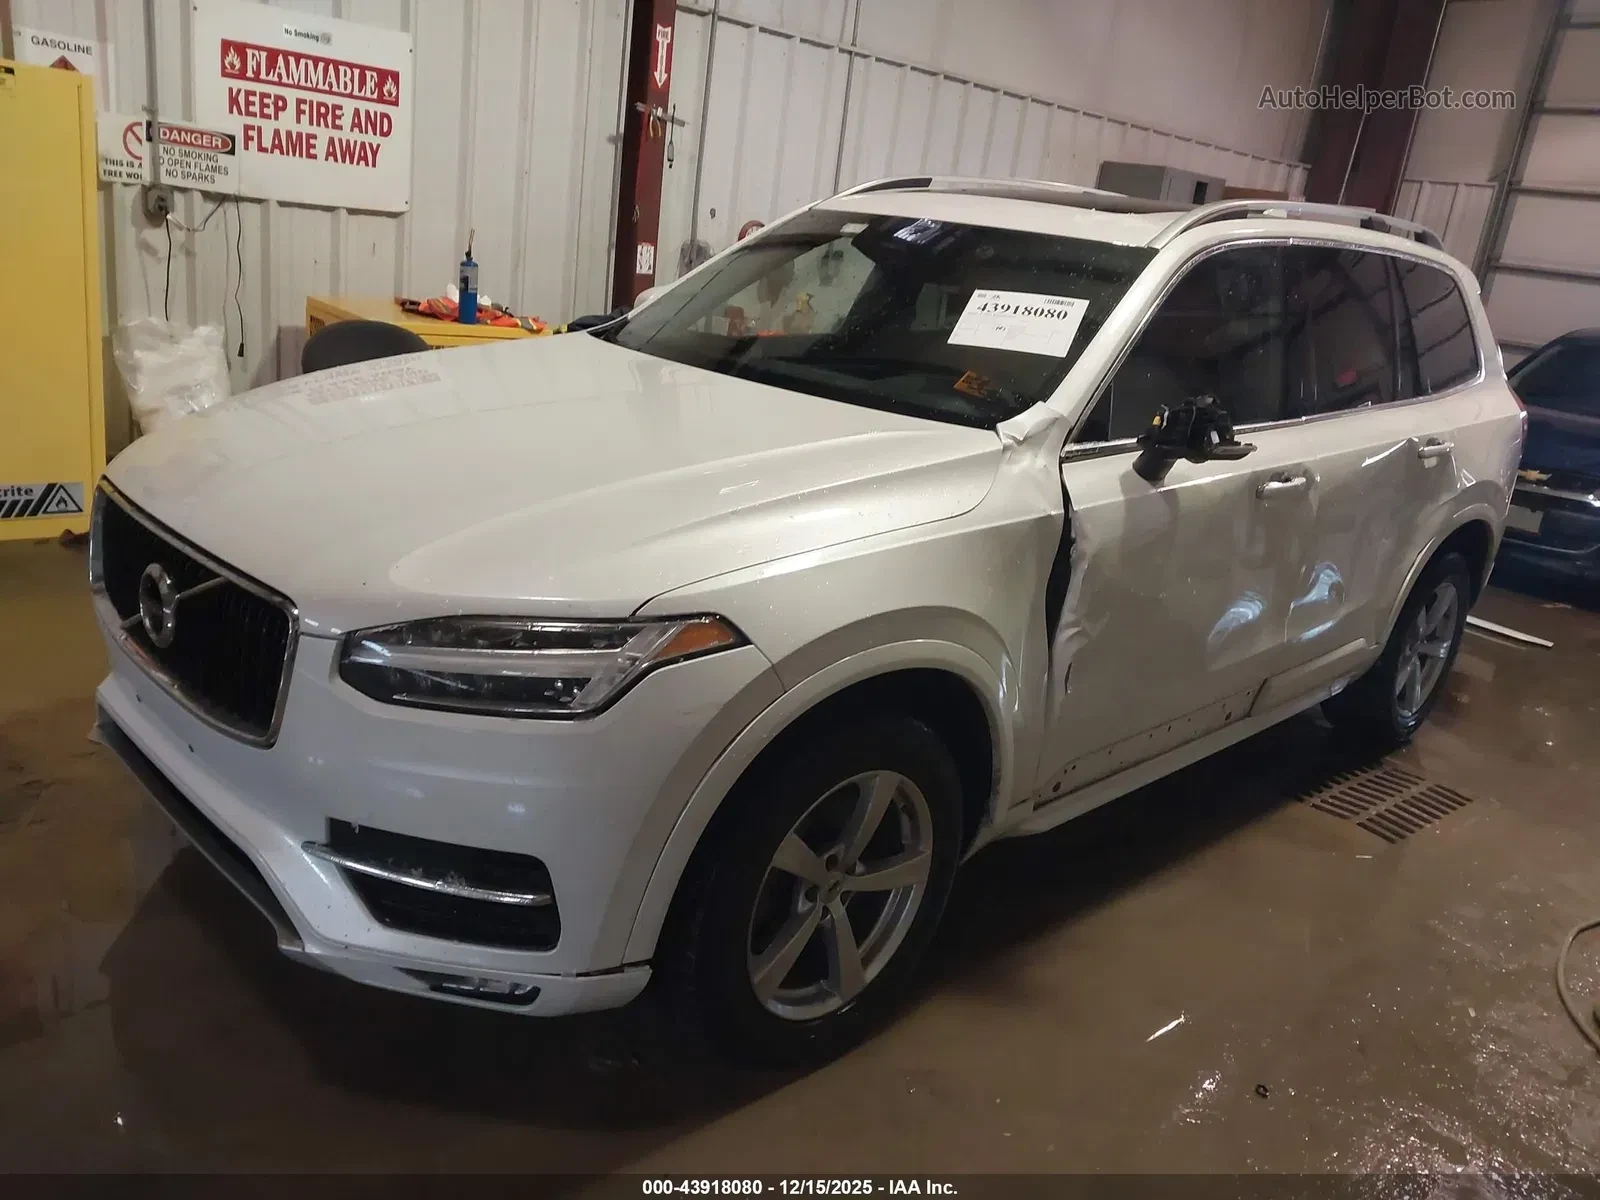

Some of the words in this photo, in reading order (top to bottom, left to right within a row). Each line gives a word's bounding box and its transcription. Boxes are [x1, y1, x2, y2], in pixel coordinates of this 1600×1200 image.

[284, 27, 292, 36] No
[294, 28, 319, 43] Smoking
[31, 35, 93, 55] GASOLINE
[245, 48, 378, 99] FLAMMABLE
[228, 86, 288, 121] KEEP
[295, 97, 344, 131] FIRE
[350, 107, 393, 138] AND
[160, 128, 222, 148] DANGER
[243, 123, 318, 160] FLAME
[324, 136, 381, 168] AWAY
[105, 157, 124, 167] THIS
[162, 146, 176, 156] NO
[178, 149, 219, 164] SMOKING
[103, 169, 122, 178] FREE
[167, 157, 191, 170] OPEN
[194, 162, 229, 176] FLAMES
[165, 168, 178, 178] NO
[180, 171, 216, 184] SPARKS
[977, 302, 1068, 320] 43918080
